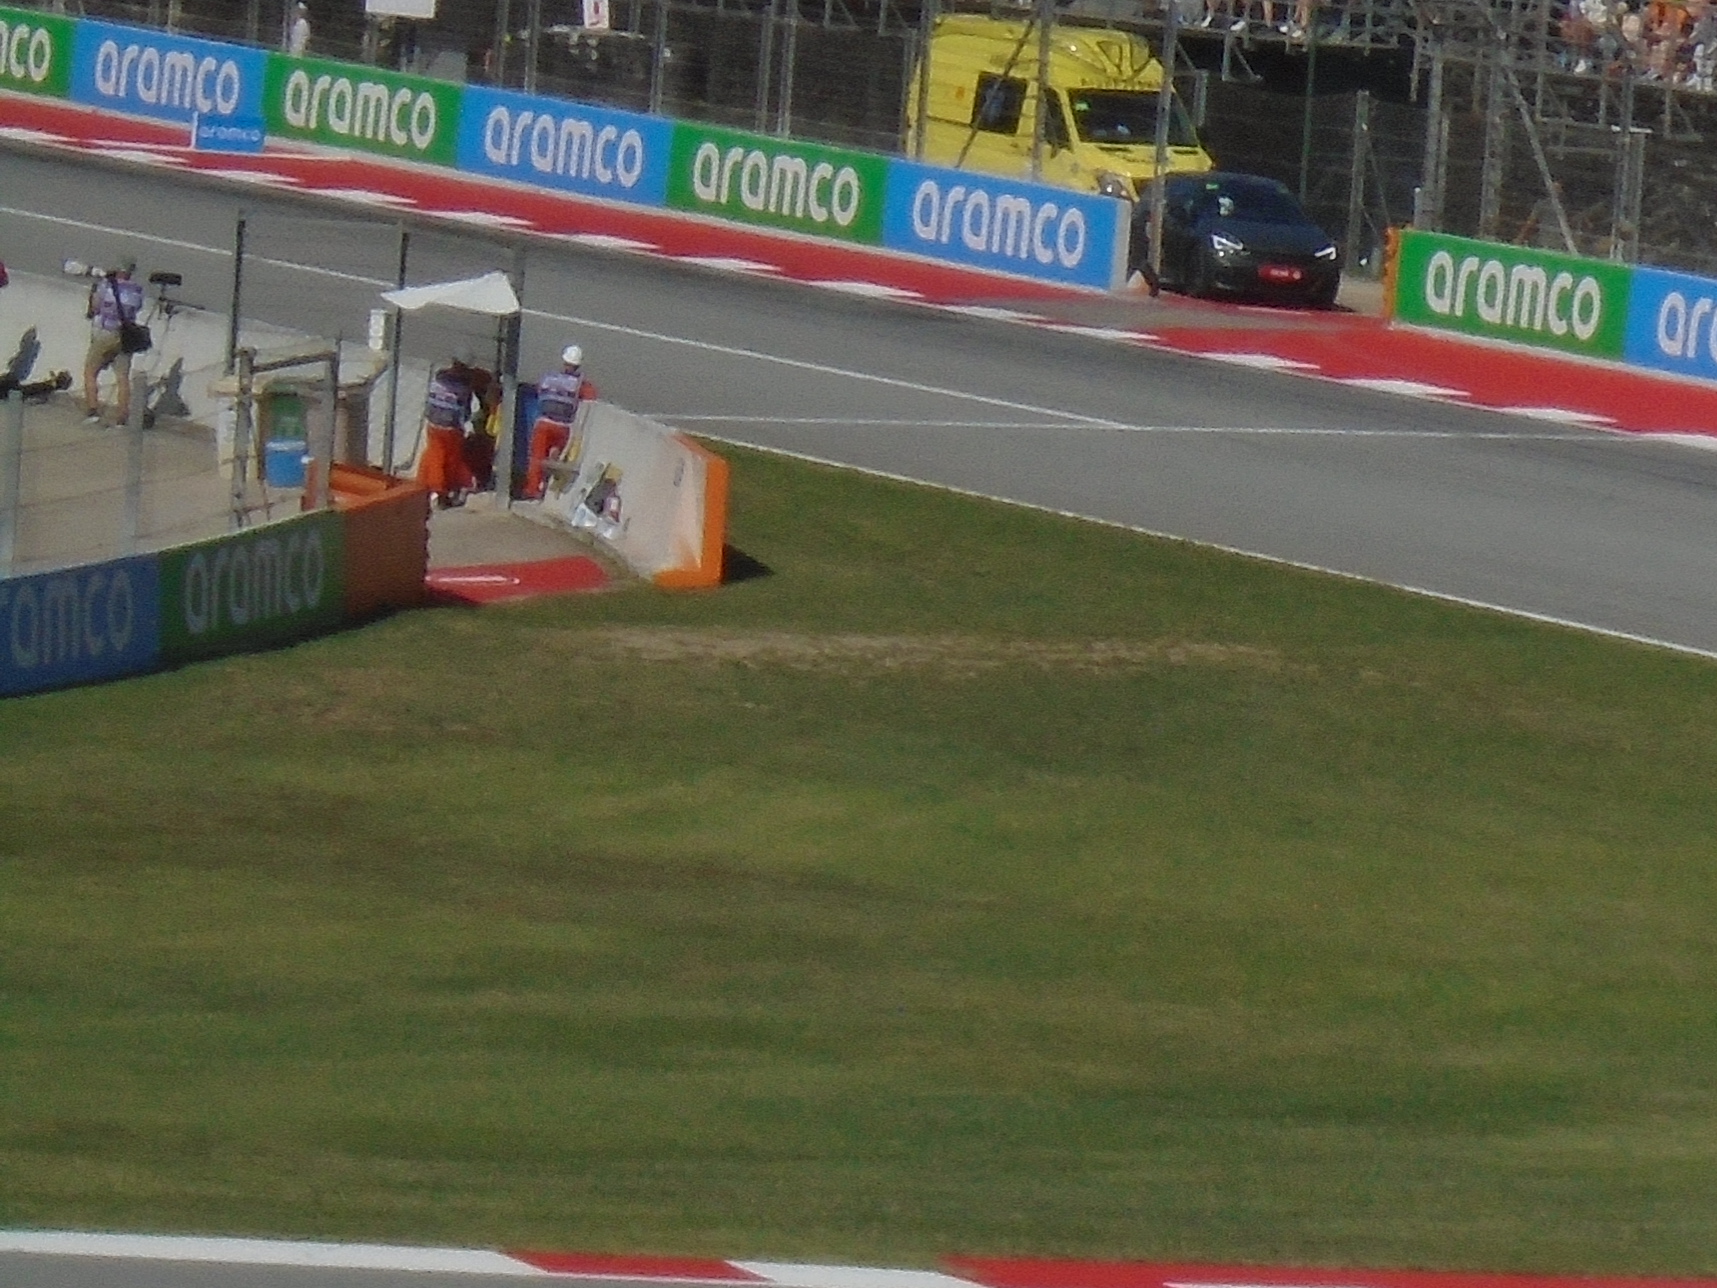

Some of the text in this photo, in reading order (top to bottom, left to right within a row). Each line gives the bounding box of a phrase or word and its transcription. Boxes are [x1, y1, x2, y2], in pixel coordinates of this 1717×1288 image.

[0, 20, 51, 84] co
[95, 39, 241, 115] aramco
[285, 69, 436, 150] aramco
[485, 105, 644, 188] aramco
[692, 142, 860, 227] aramco
[913, 180, 1086, 269] aramco
[1425, 250, 1602, 341] aramco
[184, 528, 324, 635] aramco
